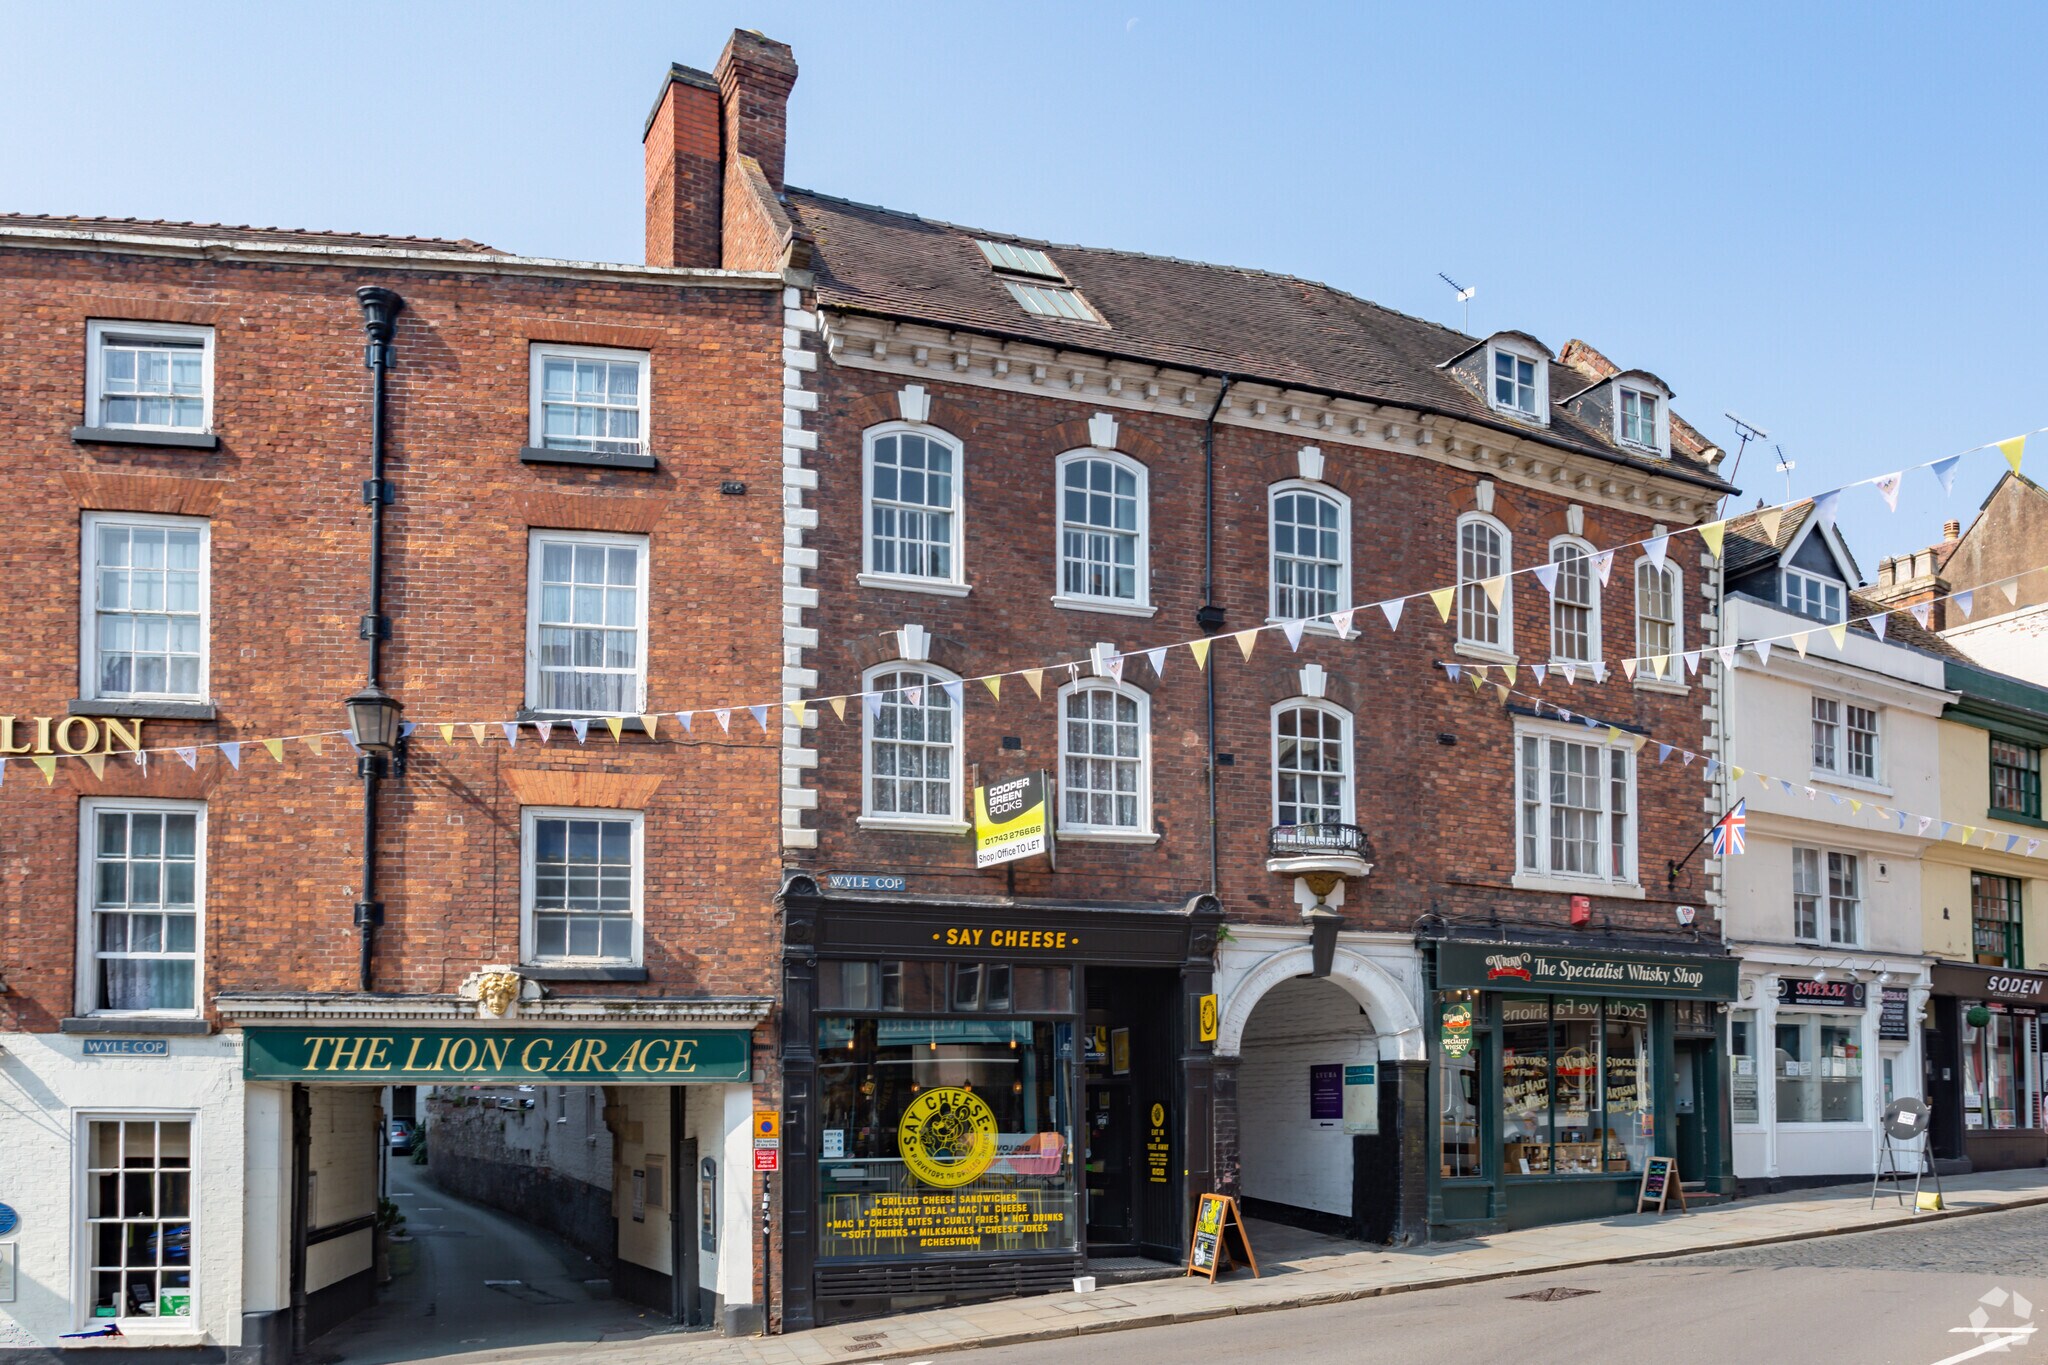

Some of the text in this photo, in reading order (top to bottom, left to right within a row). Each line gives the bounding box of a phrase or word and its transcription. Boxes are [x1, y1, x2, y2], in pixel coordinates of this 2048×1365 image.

[0, 714, 144, 755] LION
[989, 777, 1030, 797] COOPER
[989, 790, 1022, 806] GREEN
[989, 799, 1022, 816] POOKS
[985, 825, 1041, 845] 01743 276666
[1016, 843, 1026, 853] TO
[1027, 839, 1040, 851] LET
[830, 876, 903, 889] WYLE COP
[946, 928, 1067, 949] SAY CHEESE
[1535, 958, 1703, 987] The Specialist Whisky Shop
[1795, 981, 1848, 997] SHERAZ
[1987, 976, 2043, 994] SODEN
[88, 1041, 163, 1053] WYLE COP
[302, 1037, 698, 1073] THE LION GARAGE
[1503, 1056, 1548, 1067] URVEYORS
[1606, 1056, 1650, 1068] STOCKISS
[903, 1092, 990, 1145] SAY CHEESE
[882, 1194, 1017, 1206] GRILLED CHEESE SANDWICHES
[870, 1207, 921, 1216] BREAKFAST
[925, 1206, 948, 1215] DEAL
[958, 1206, 978, 1214] MAC
[994, 1204, 1027, 1213] CHEESE
[834, 1220, 854, 1229] MAC
[869, 1218, 904, 1227] CHEESE
[907, 1217, 933, 1226] BITES
[943, 1216, 972, 1225] CURLY
[975, 1215, 999, 1224] FRIES
[1012, 1214, 1030, 1223] HOT
[1032, 1212, 1064, 1222] DRINKS
[848, 1224, 1048, 1239] SOFT DRINKS MILKSHAKES CHEESE JOKES
[920, 1236, 981, 1247] #CHEESYNOW
